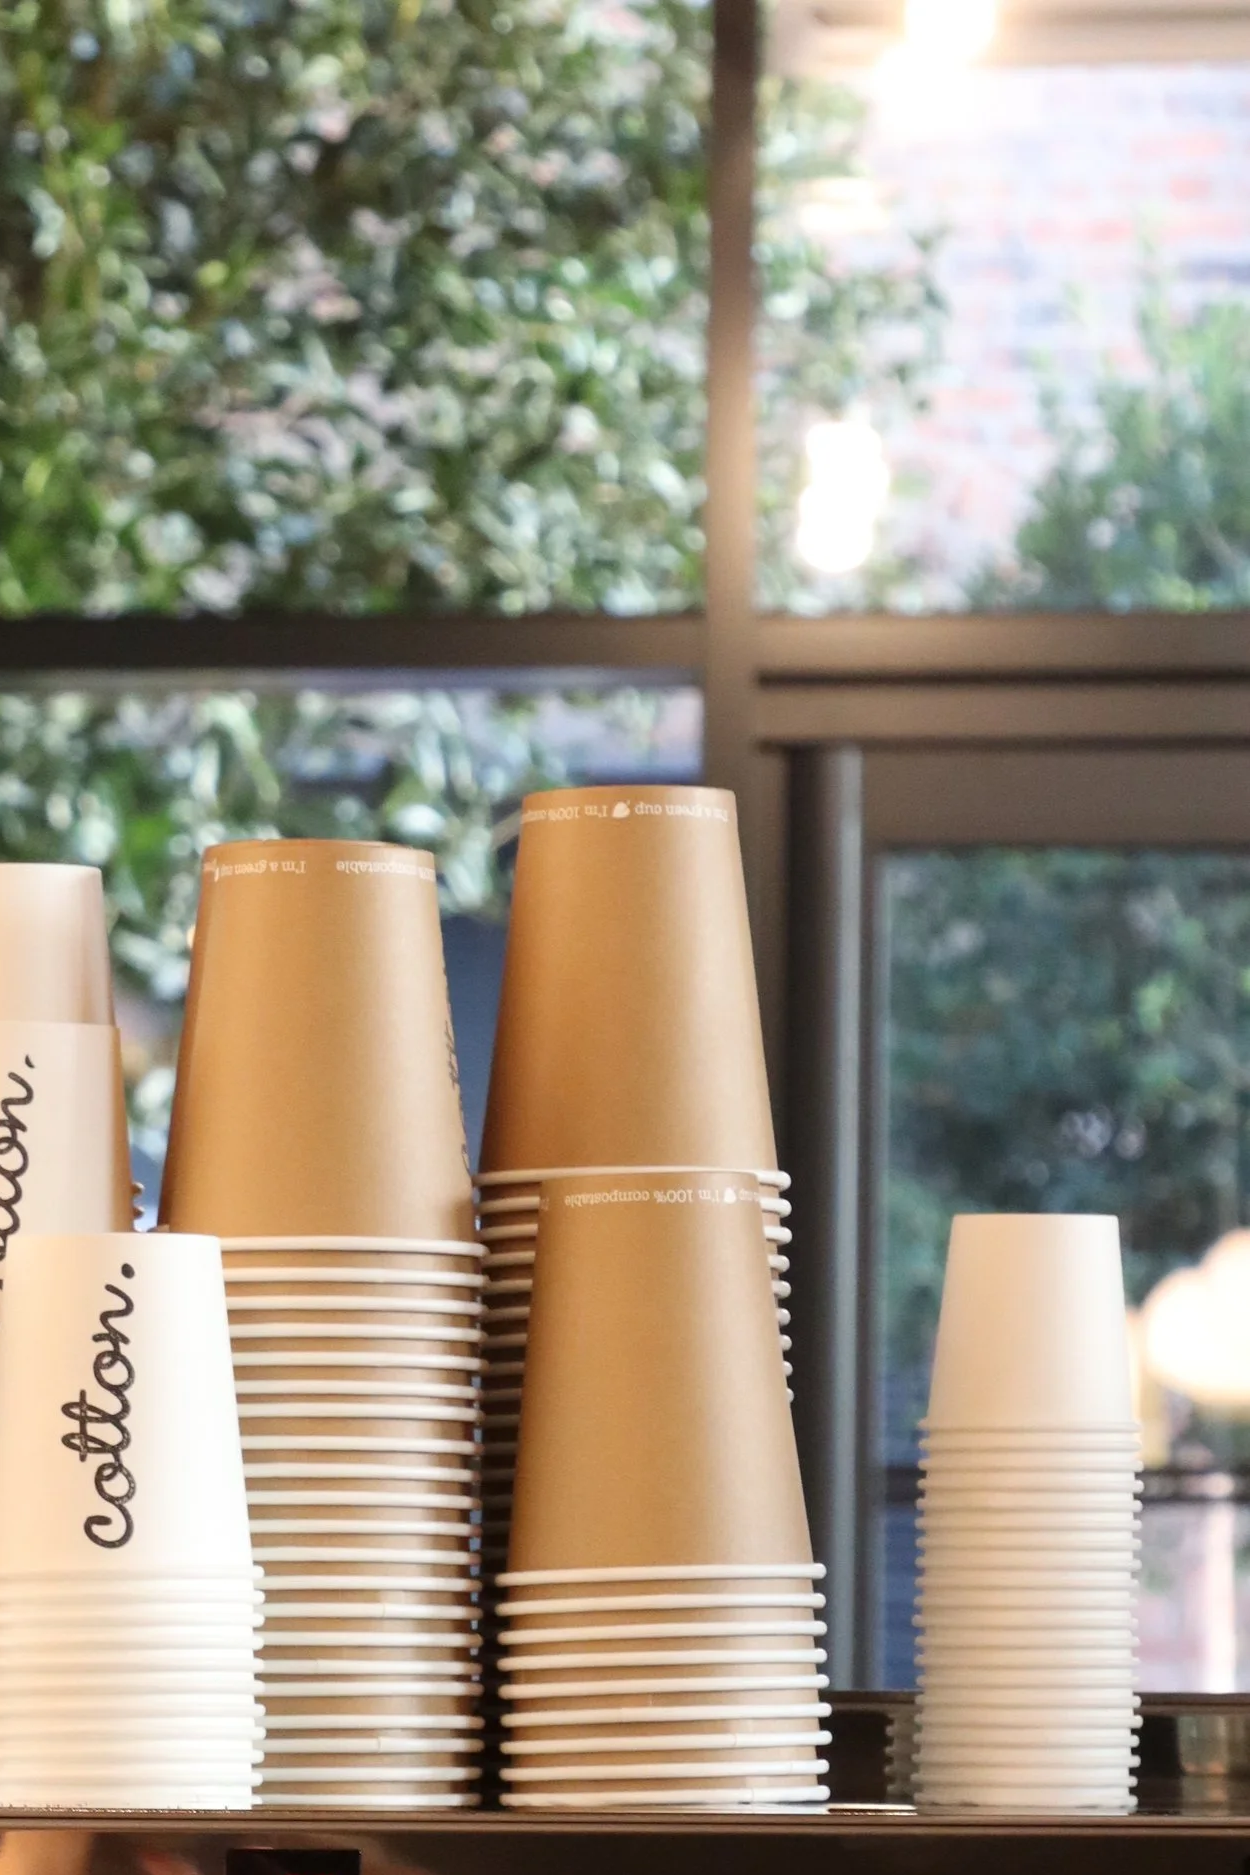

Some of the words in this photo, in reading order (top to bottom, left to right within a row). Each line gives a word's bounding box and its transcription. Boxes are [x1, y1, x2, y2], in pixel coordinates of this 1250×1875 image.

[584, 804, 608, 819] I'm
[634, 801, 662, 815] cup
[235, 859, 267, 875] green
[269, 861, 279, 872] a
[282, 860, 307, 874] I'm
[564, 1188, 651, 1208] compostable
[655, 1189, 694, 1204] 100%
[699, 1189, 720, 1204] I'm
[60, 1262, 137, 1550] cotton.
